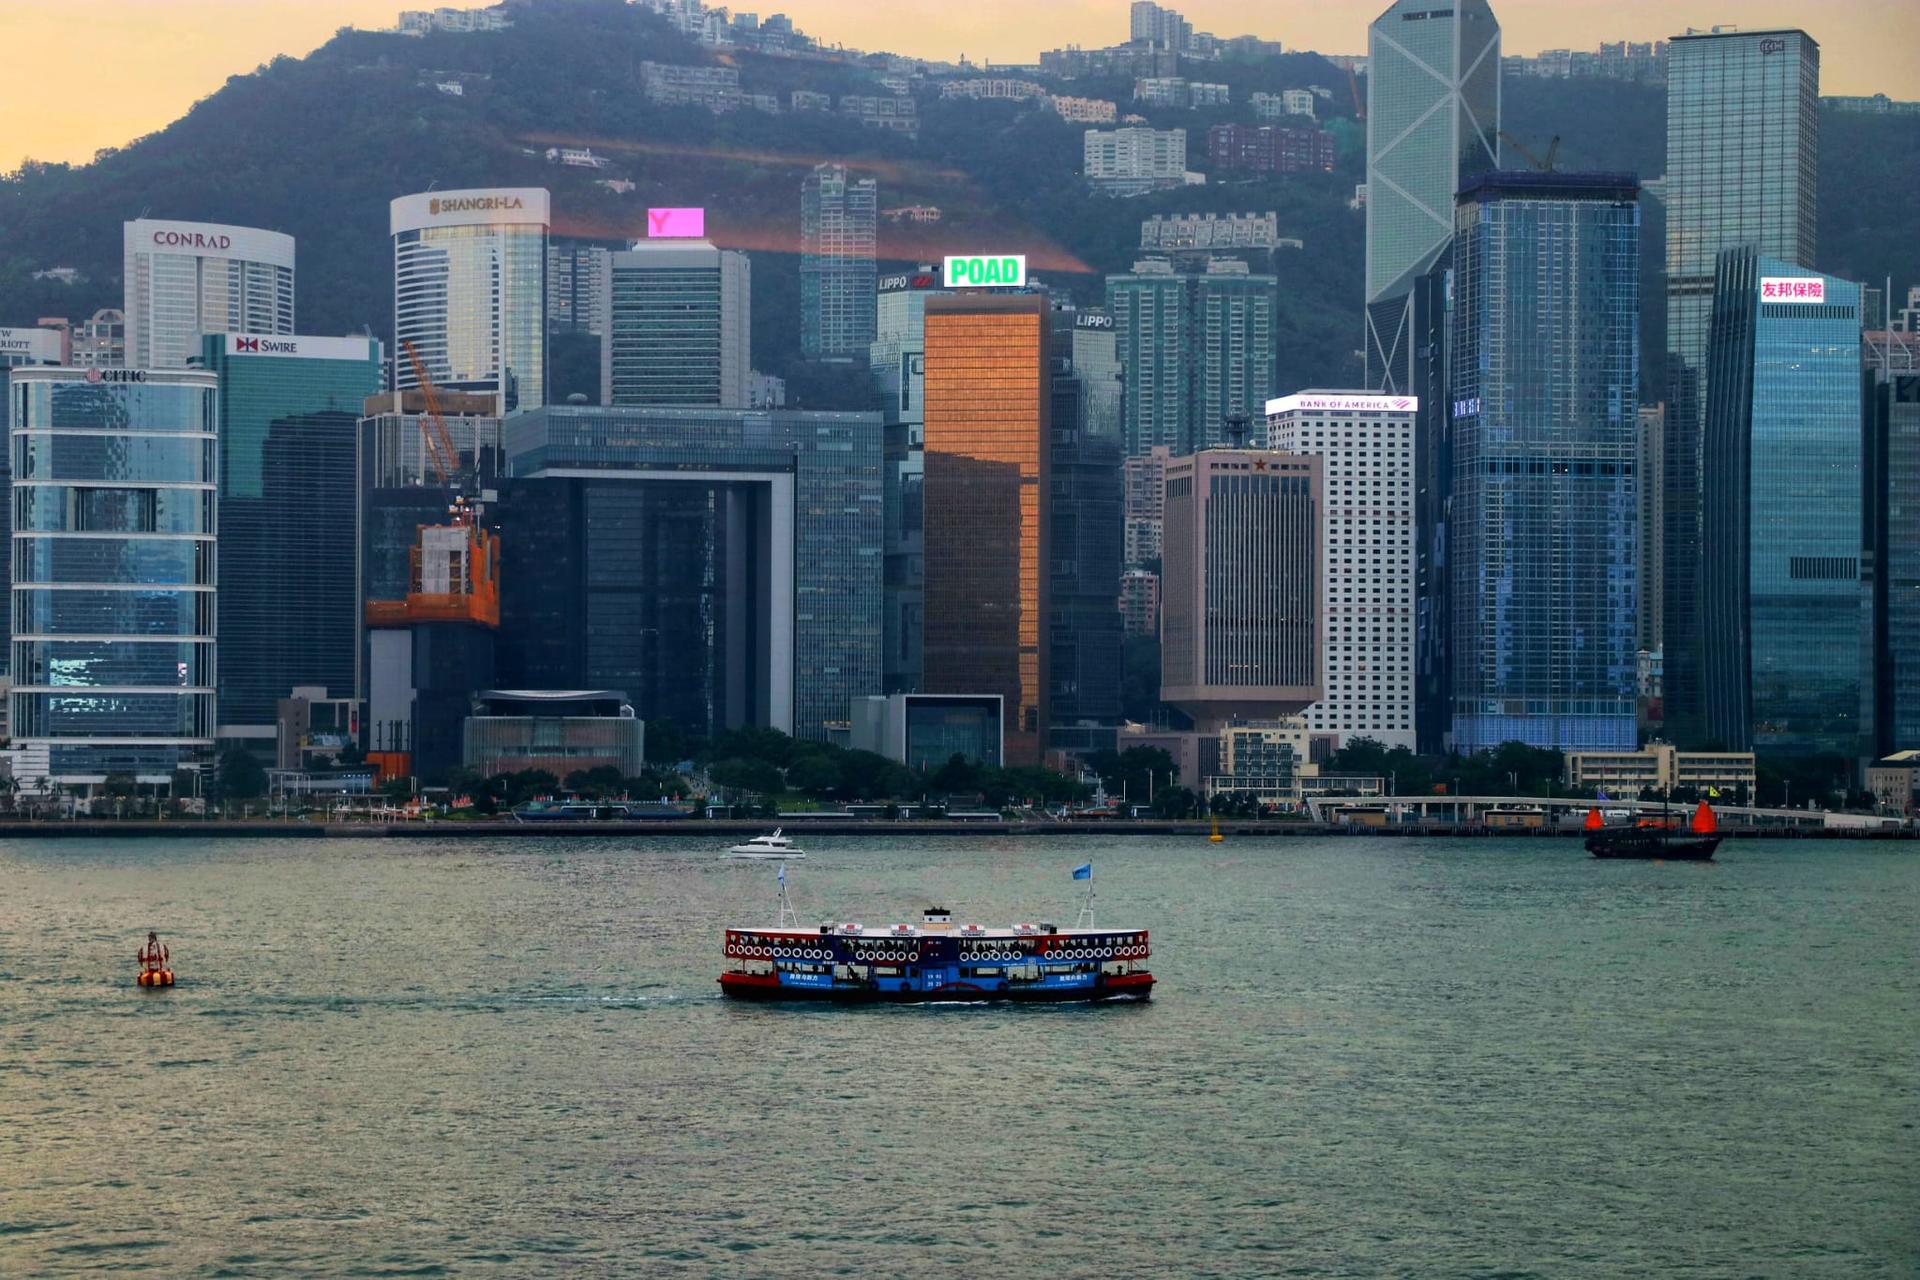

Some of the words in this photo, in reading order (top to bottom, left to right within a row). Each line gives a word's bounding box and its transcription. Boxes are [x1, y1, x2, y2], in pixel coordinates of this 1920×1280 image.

[441, 197, 523, 213] SHANGRI-LA
[649, 210, 671, 234] Y
[153, 231, 231, 249] CONRAD
[951, 258, 1018, 284] POAD
[879, 275, 907, 290] LIPPO
[1762, 282, 1823, 298] 友邦保險
[1076, 315, 1113, 328] LIPPO
[0, 340, 31, 349] RIOTT
[102, 369, 147, 383] CITIC
[1344, 401, 1389, 409] AMERICA
